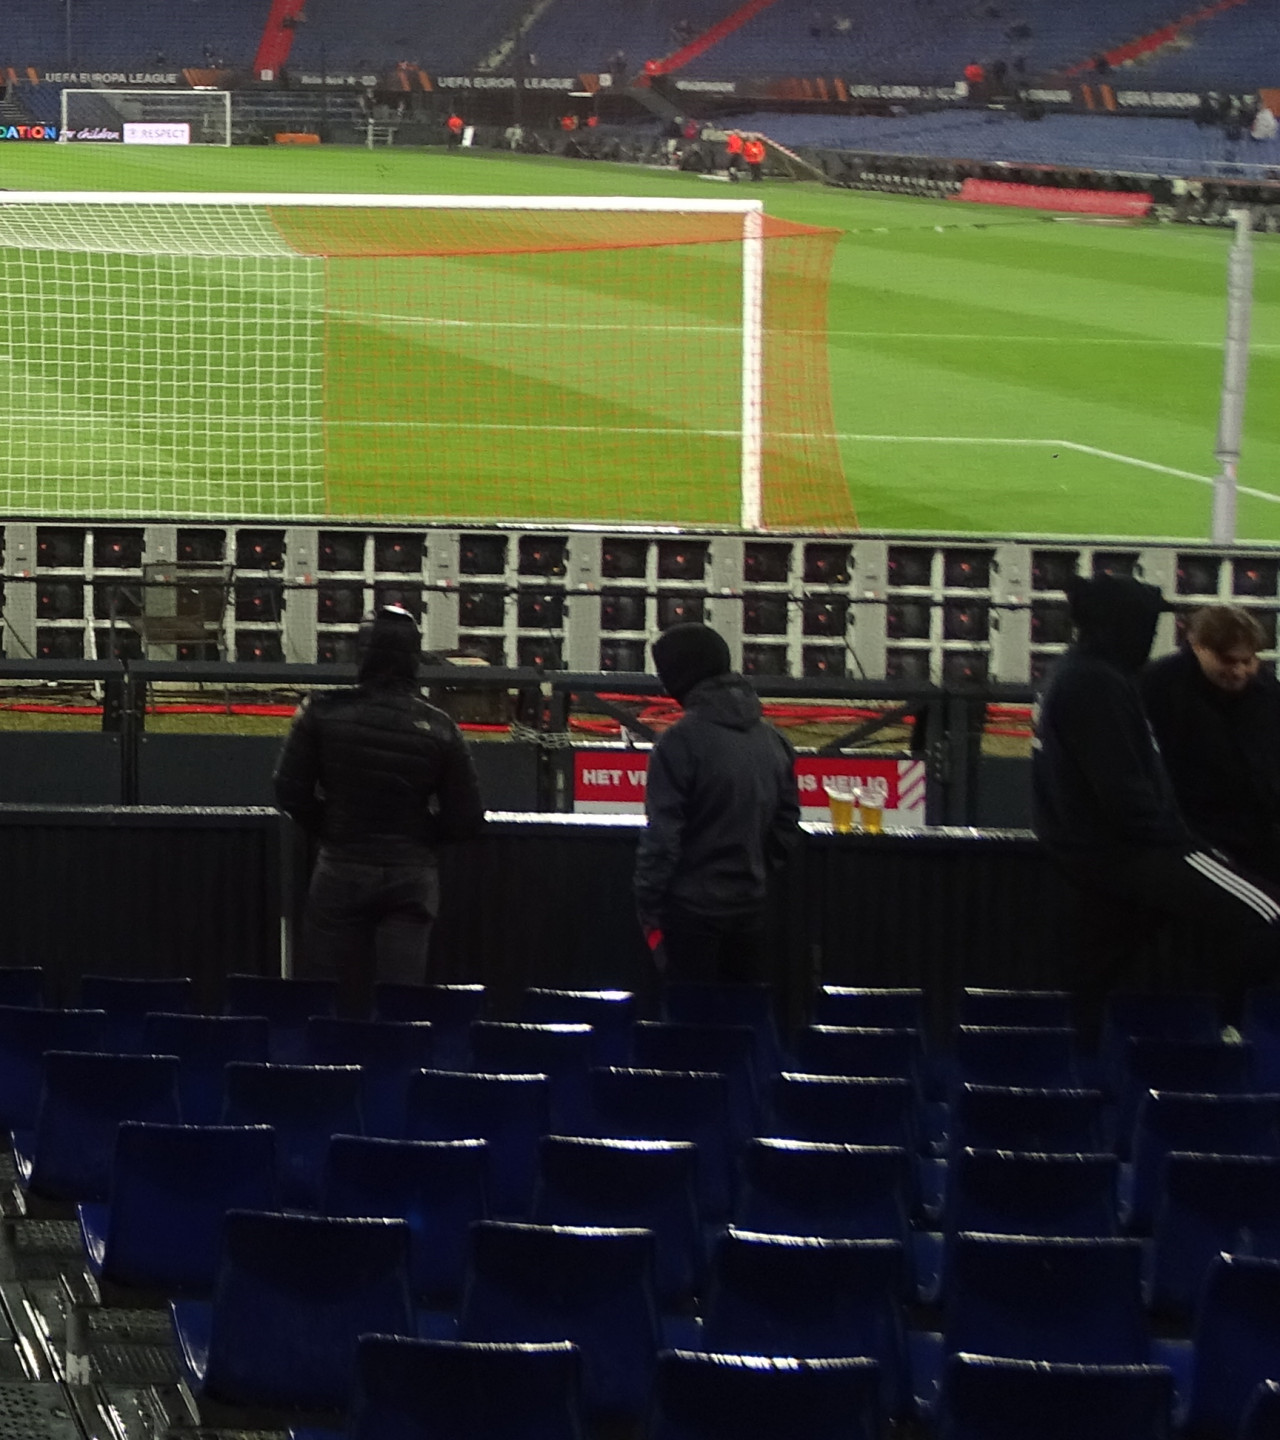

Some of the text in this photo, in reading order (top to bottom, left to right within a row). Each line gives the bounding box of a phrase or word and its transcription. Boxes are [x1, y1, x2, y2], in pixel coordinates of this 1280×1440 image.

[45, 73, 177, 84] UEFA EUROPA LEAGUE
[76, 127, 119, 140] children
[141, 129, 186, 139] RESPECT
[582, 769, 621, 786] HET
